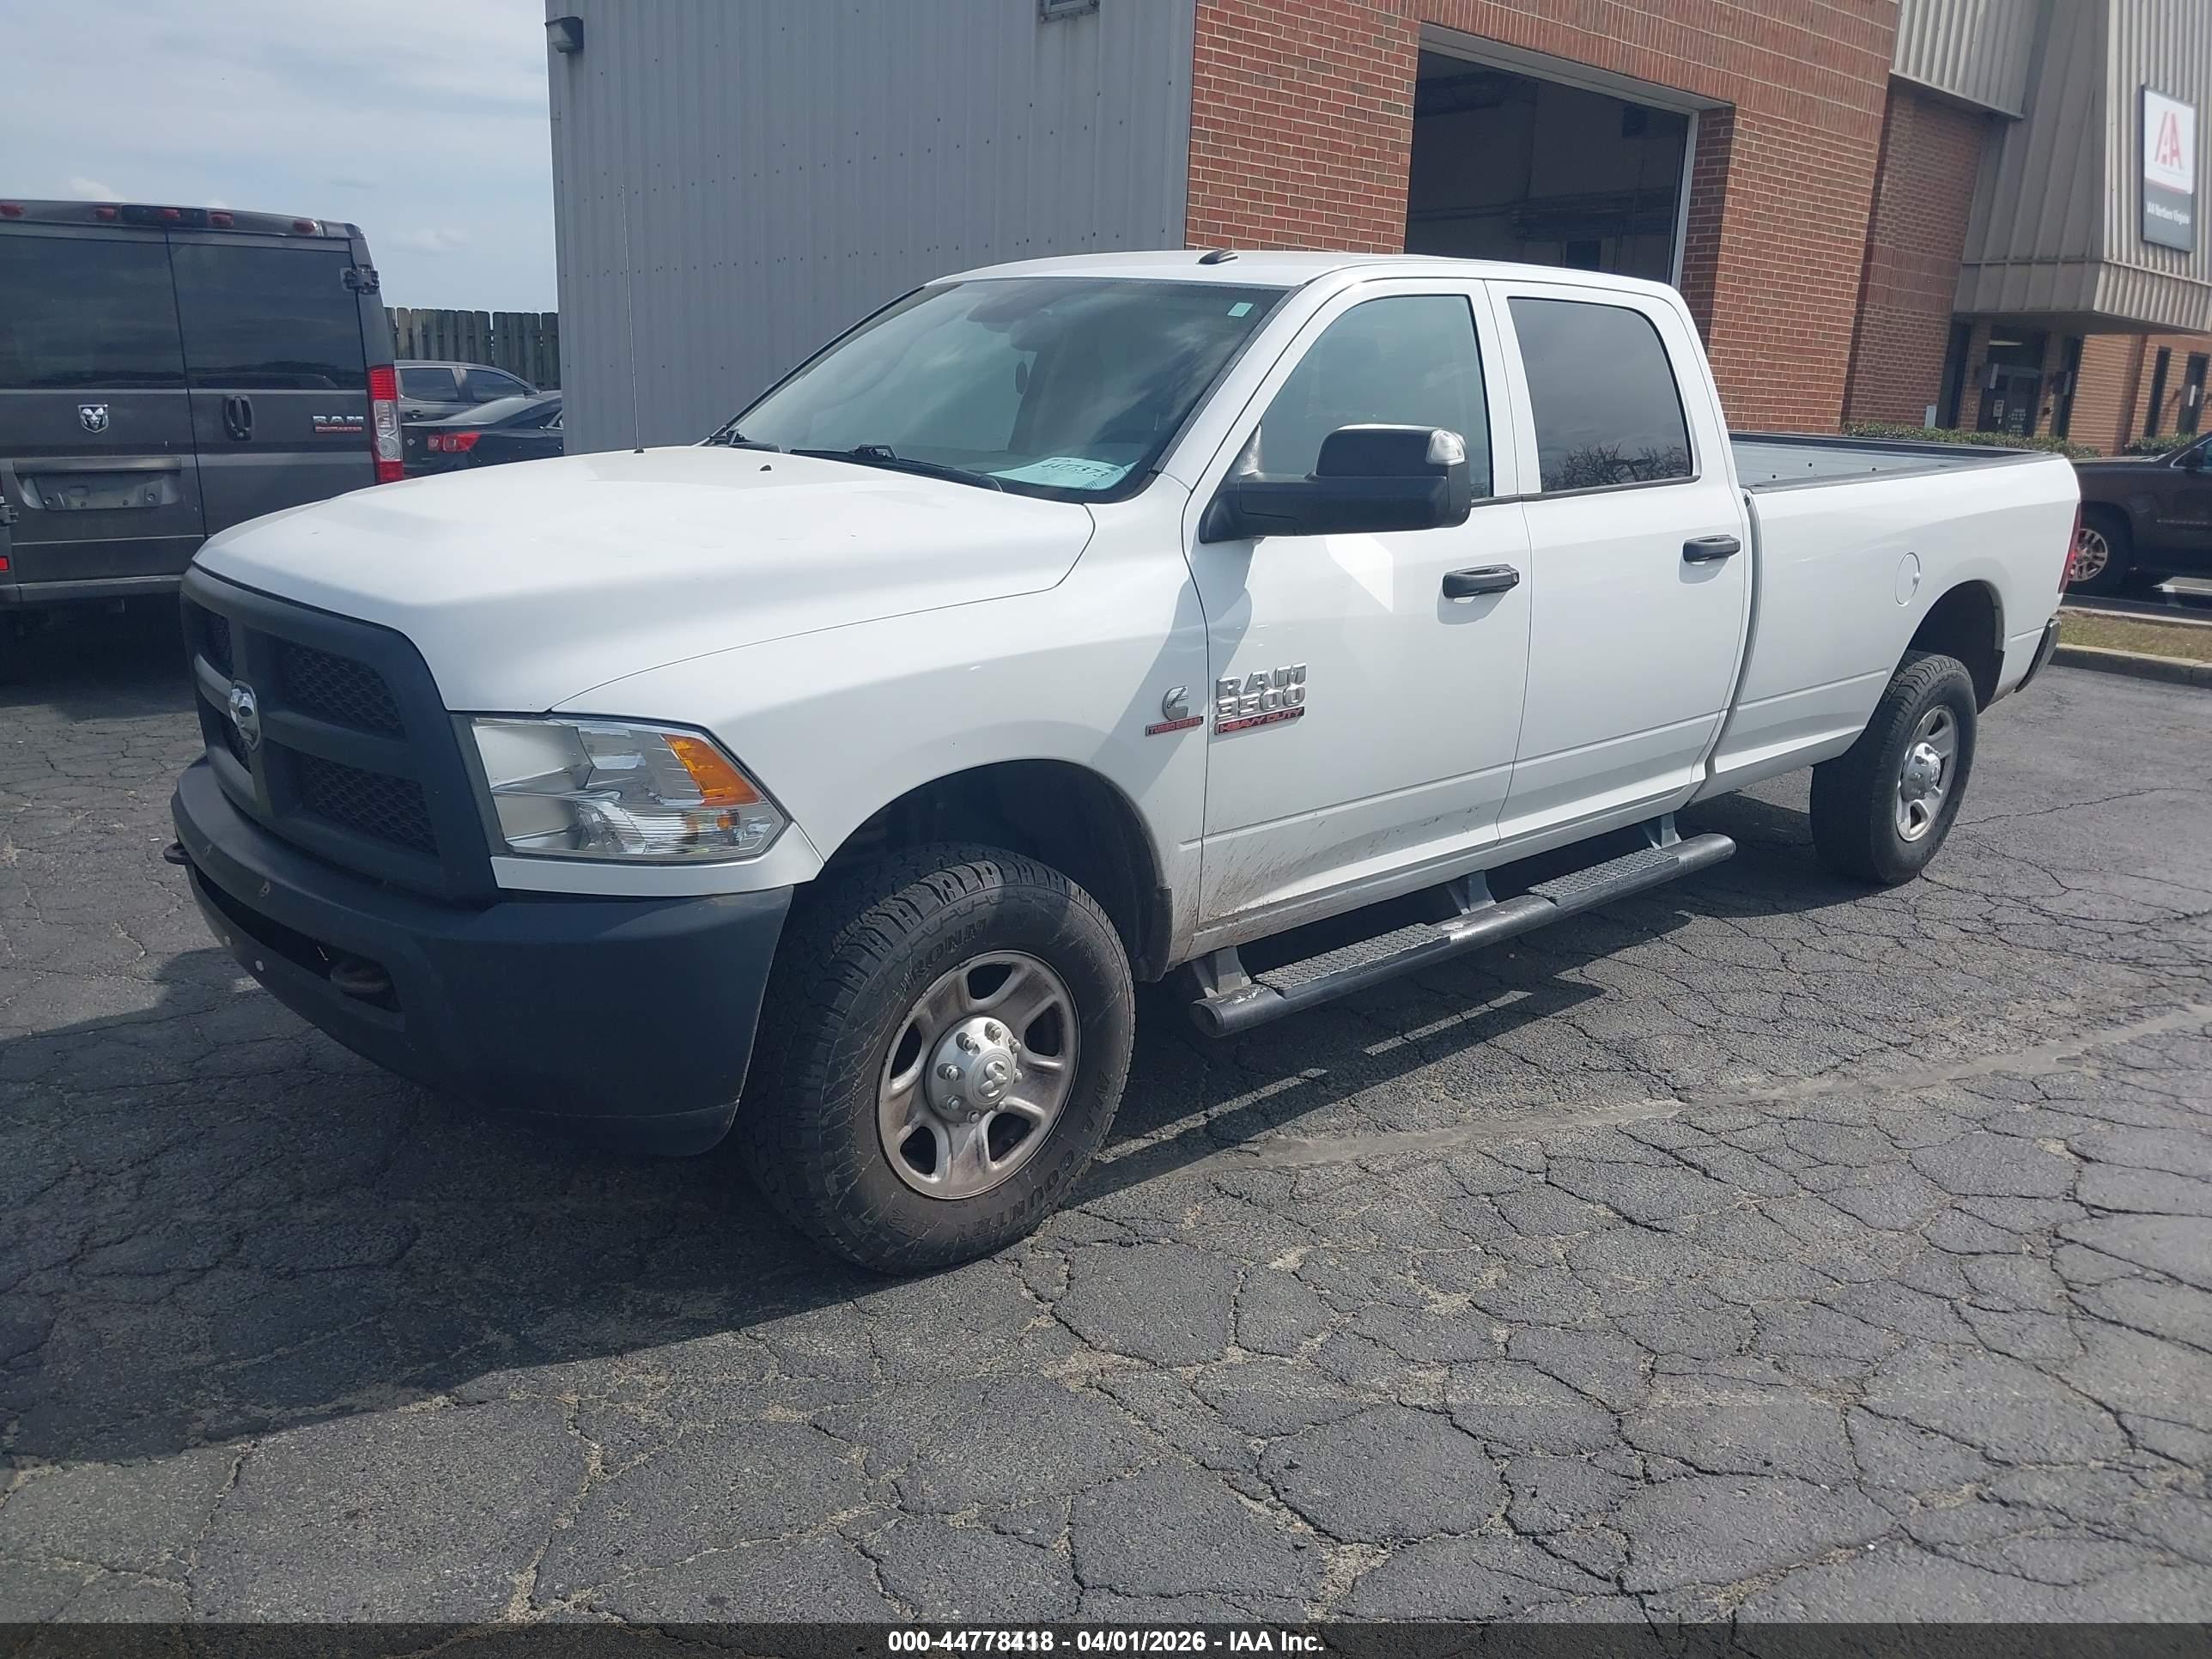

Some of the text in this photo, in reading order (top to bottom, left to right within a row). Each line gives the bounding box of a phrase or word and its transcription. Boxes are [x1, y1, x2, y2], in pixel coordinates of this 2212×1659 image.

[1216, 662, 1306, 698] RAM
[1215, 684, 1306, 720] 3500
[1219, 708, 1301, 733] HEAVY DUTY
